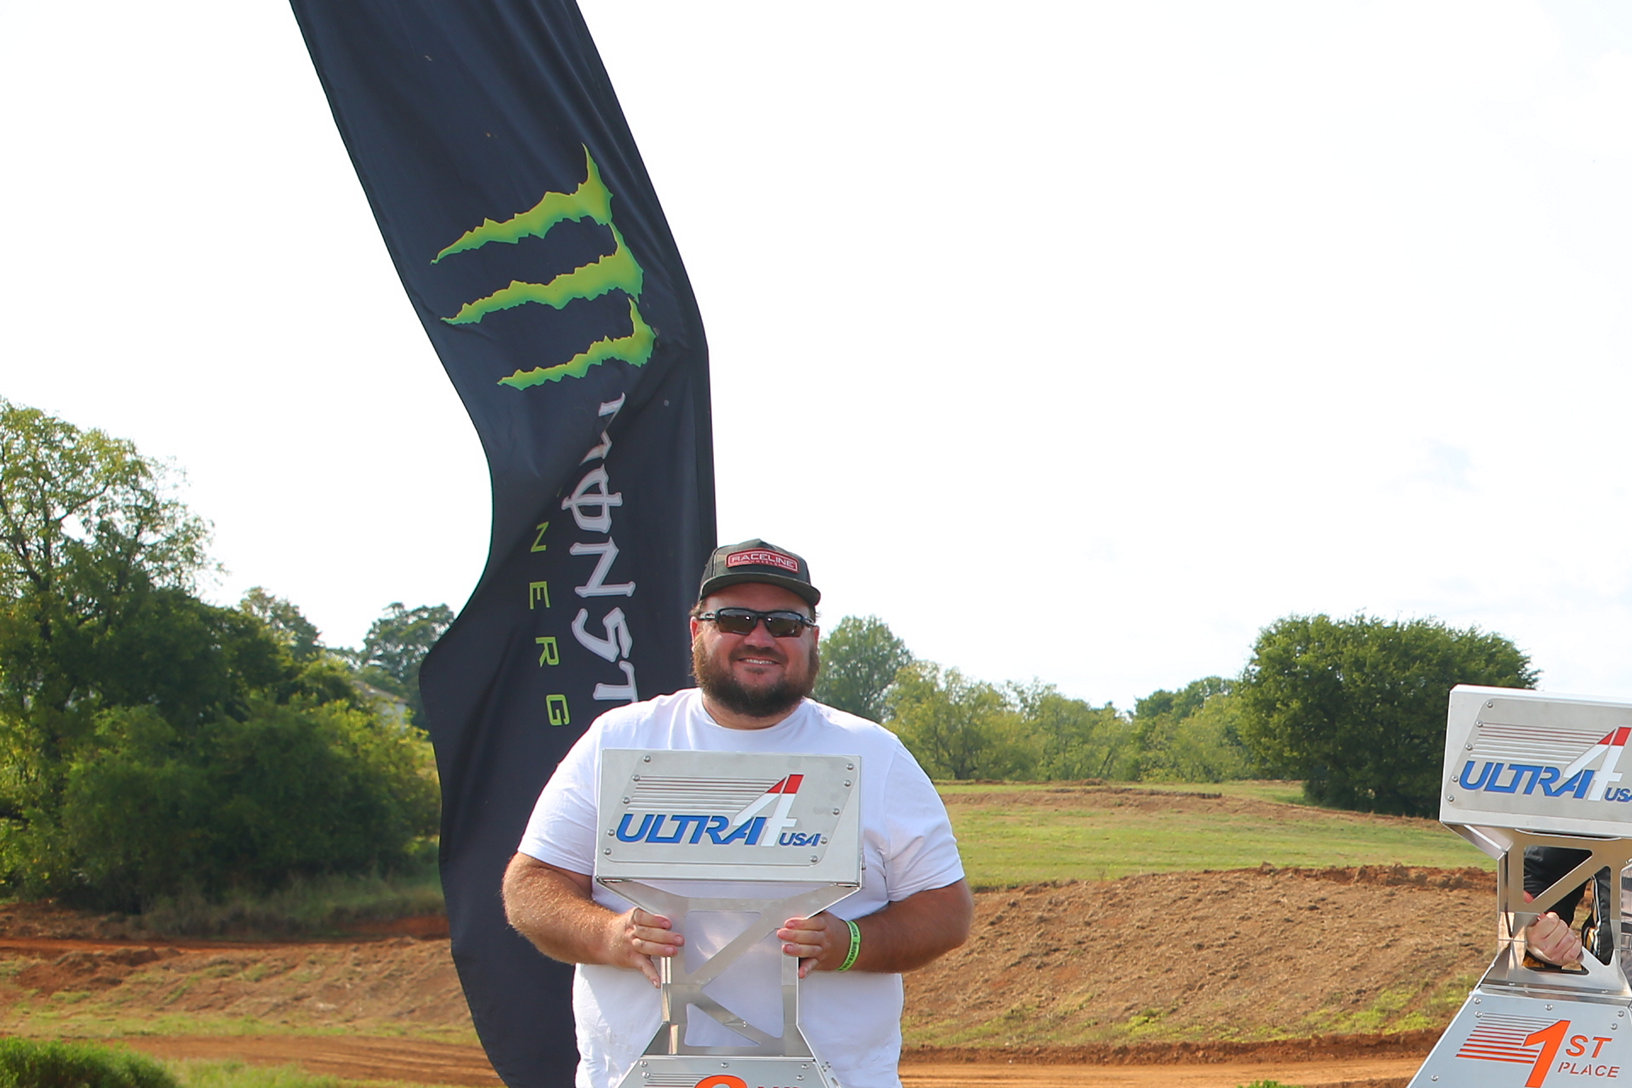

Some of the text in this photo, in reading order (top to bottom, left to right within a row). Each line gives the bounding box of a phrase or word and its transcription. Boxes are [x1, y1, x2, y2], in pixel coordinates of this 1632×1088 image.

[731, 553, 794, 566] RACELINE
[779, 832, 821, 847] USA
[1522, 1020, 1613, 1088] 1ST
[1557, 1062, 1621, 1078] PLACE
